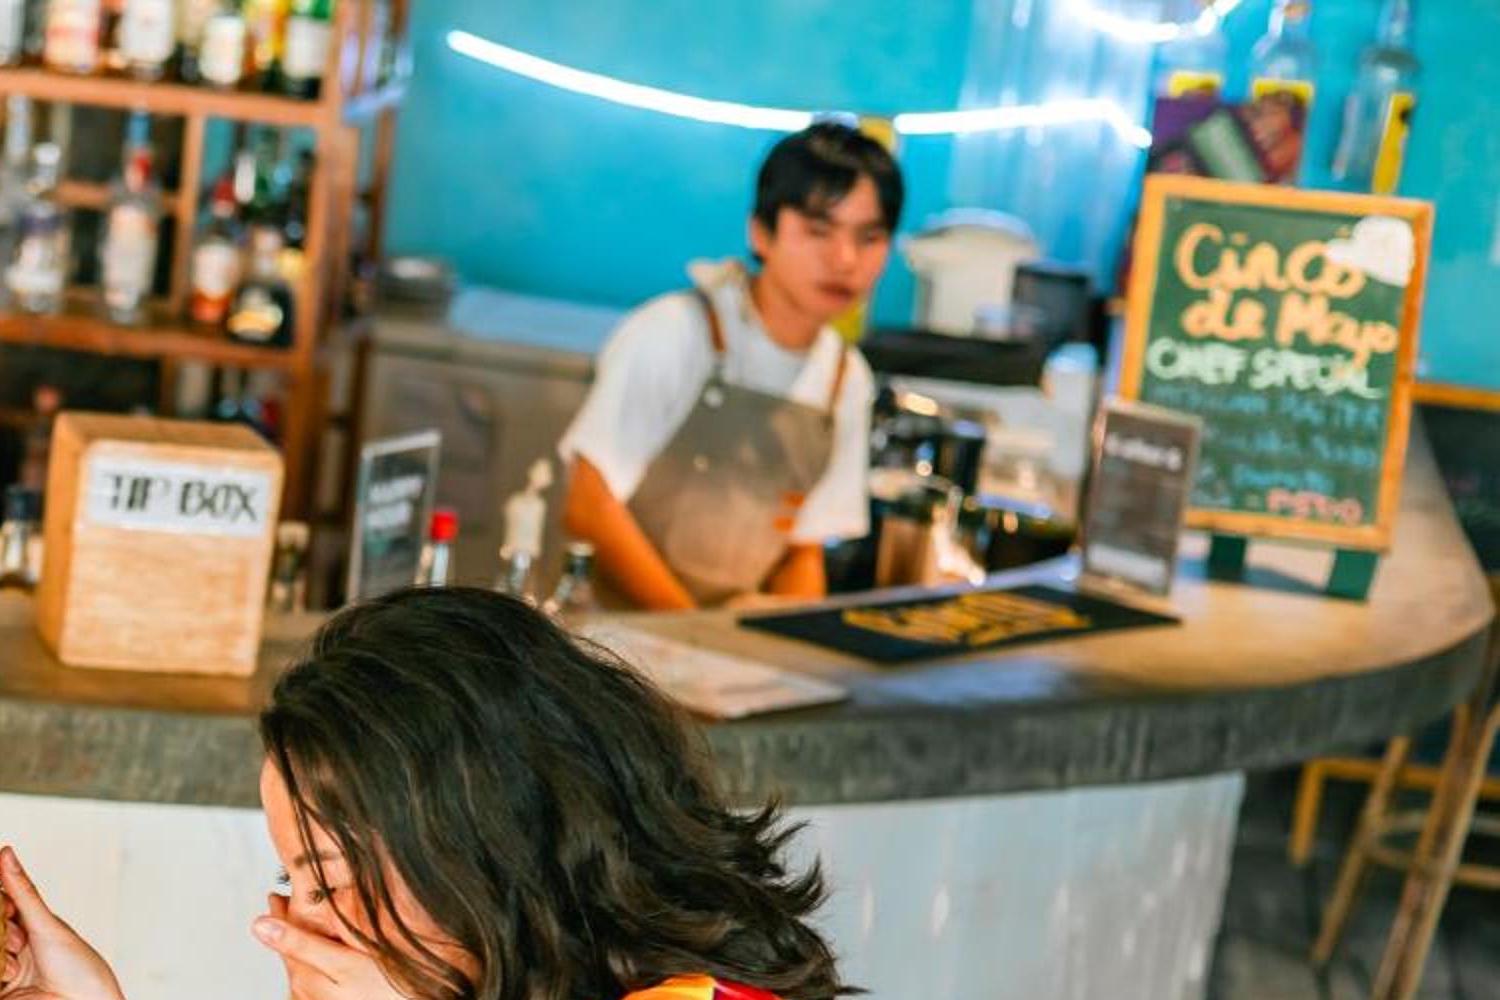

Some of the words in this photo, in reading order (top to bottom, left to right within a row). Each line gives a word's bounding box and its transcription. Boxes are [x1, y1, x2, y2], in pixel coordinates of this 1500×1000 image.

[1174, 223, 1367, 298] Cinco
[1181, 288, 1267, 341] de
[1275, 290, 1398, 368] Mayo
[179, 480, 257, 522] BOX
